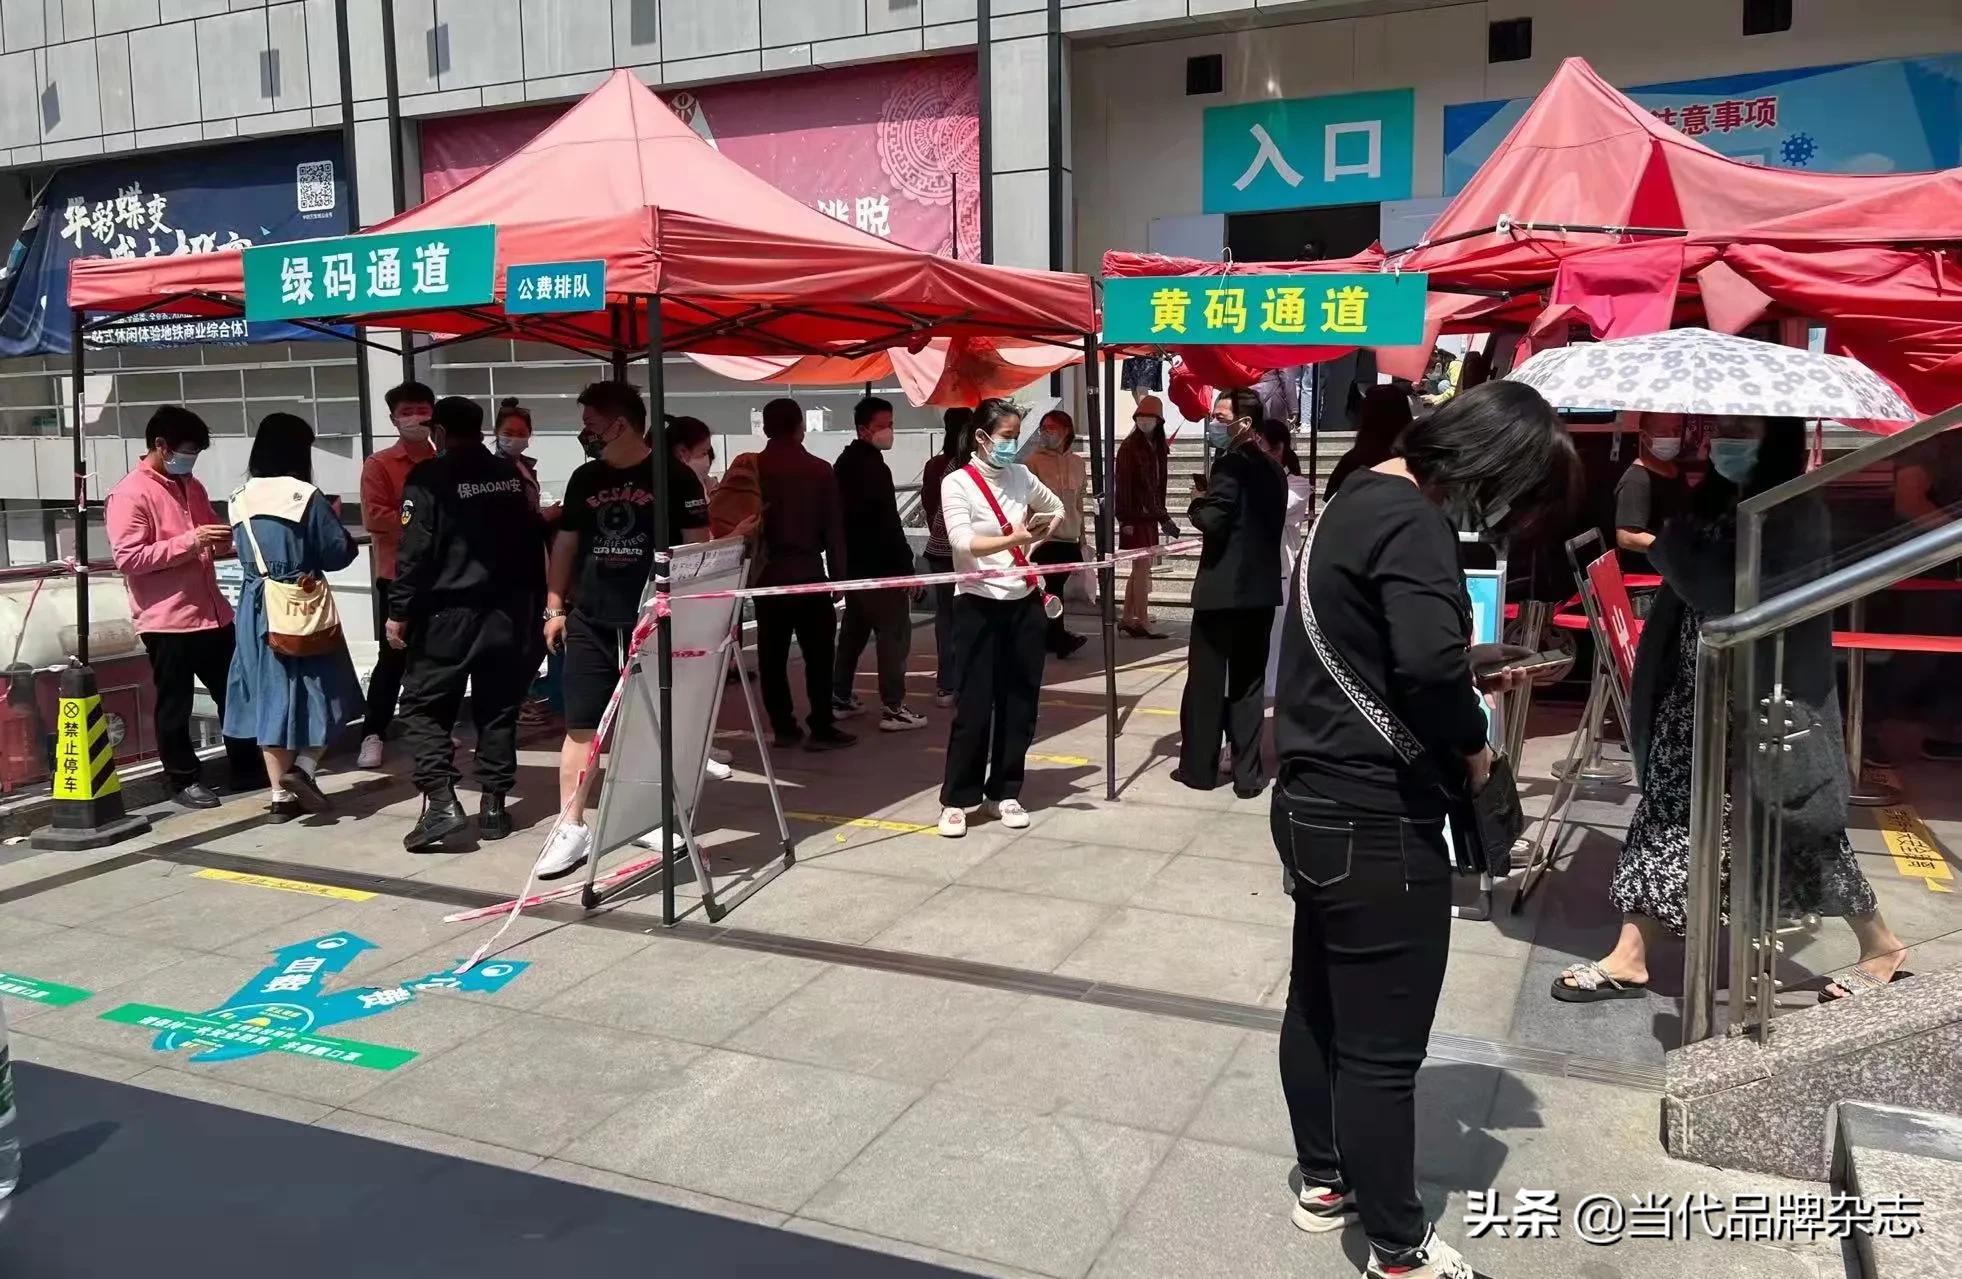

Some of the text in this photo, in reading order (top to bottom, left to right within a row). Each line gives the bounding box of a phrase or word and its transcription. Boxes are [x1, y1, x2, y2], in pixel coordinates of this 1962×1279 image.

[1232, 120, 1382, 191] 入口
[61, 181, 172, 249] 华彩蝶变
[281, 242, 450, 305] 绿码通道
[517, 273, 592, 300] 公费排队
[1150, 286, 1370, 334] 黄码通道
[63, 722, 79, 793] 禁止停车
